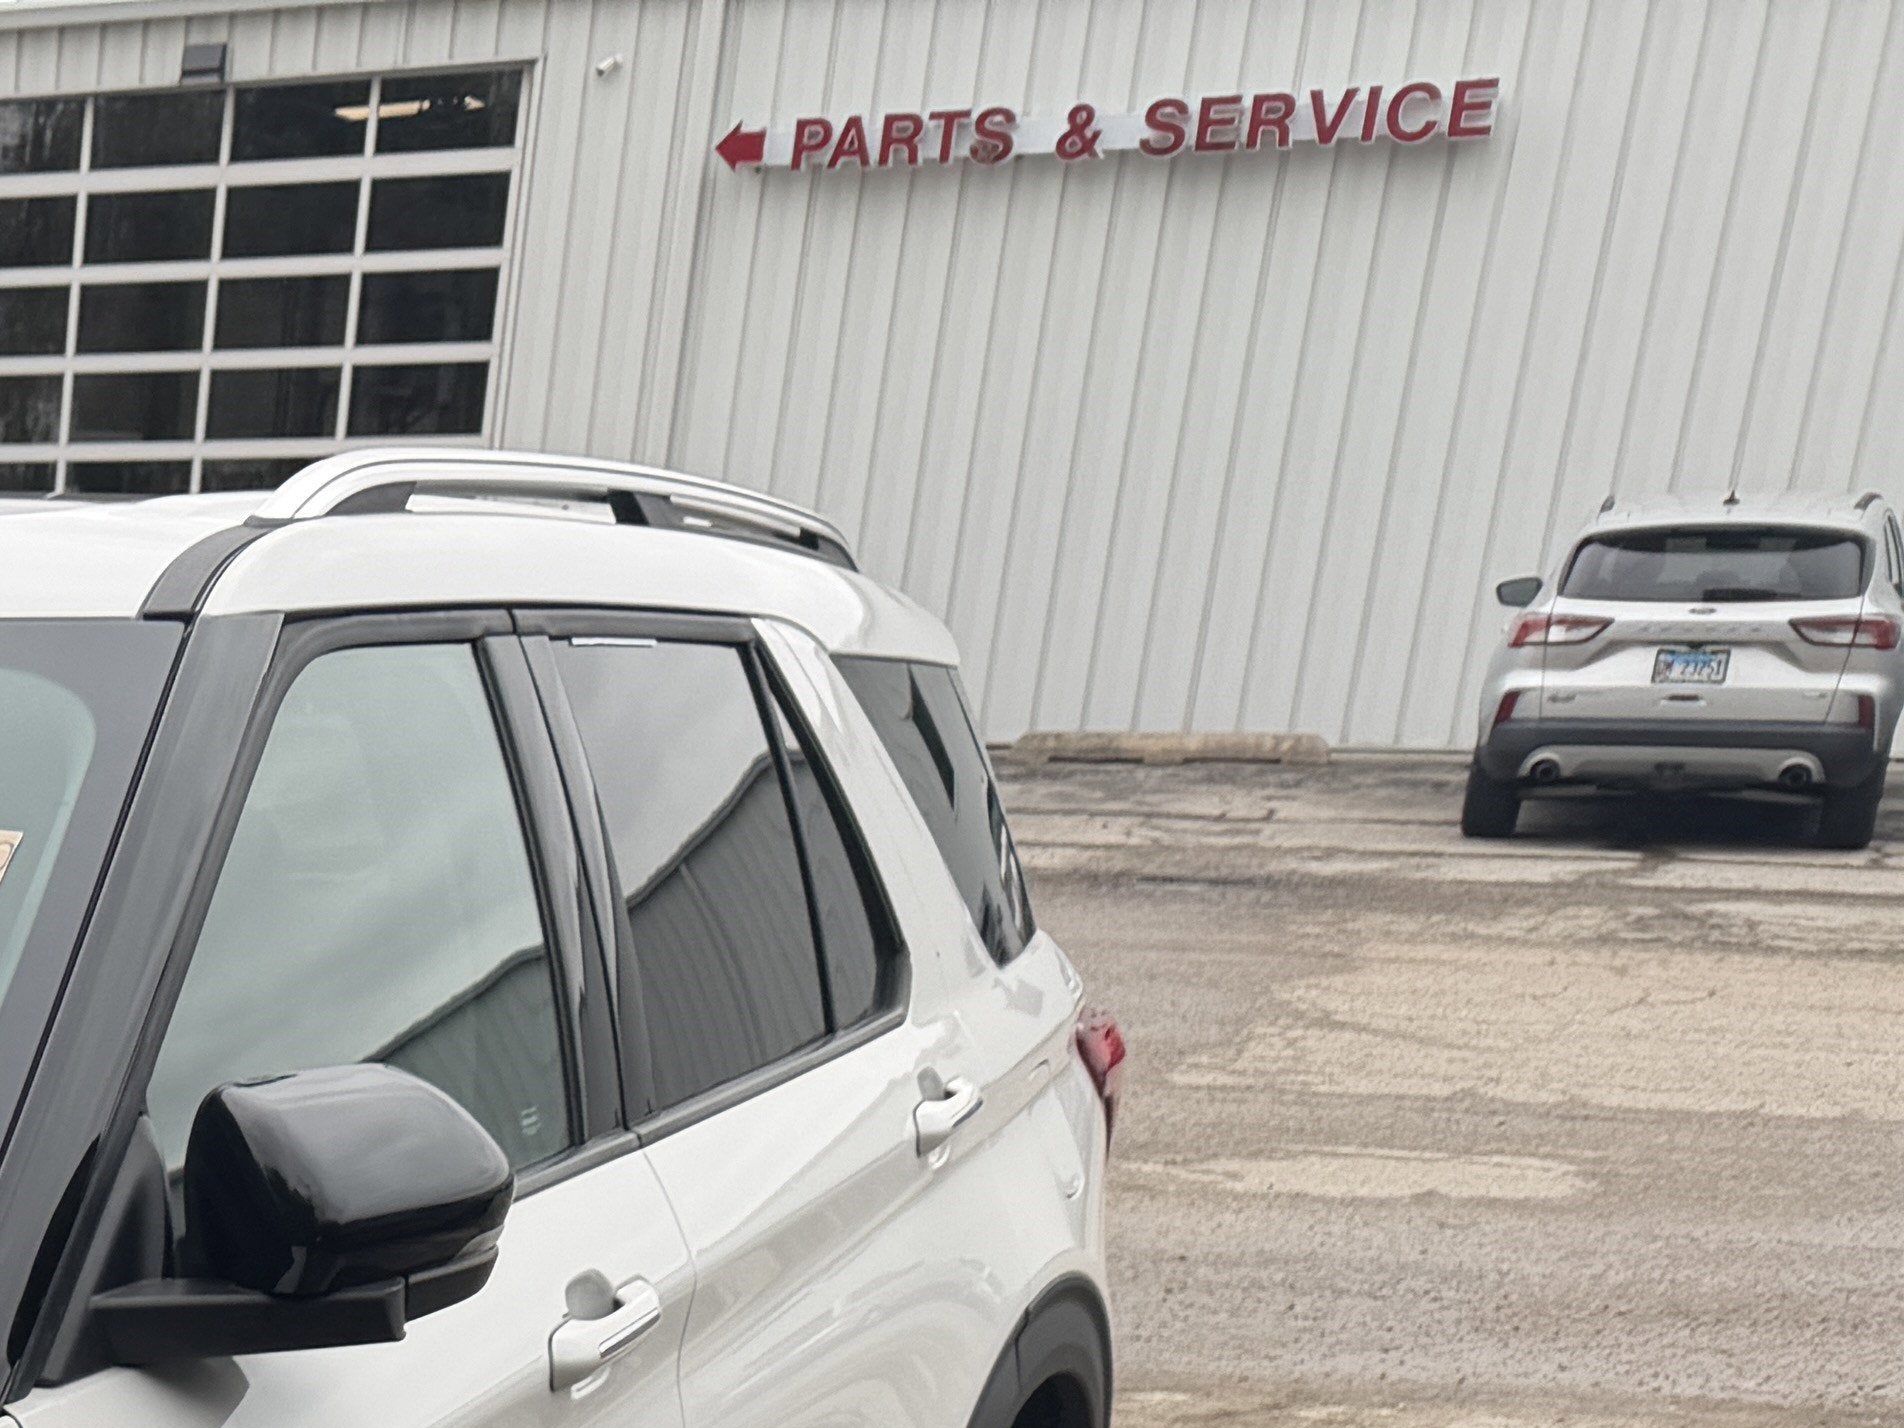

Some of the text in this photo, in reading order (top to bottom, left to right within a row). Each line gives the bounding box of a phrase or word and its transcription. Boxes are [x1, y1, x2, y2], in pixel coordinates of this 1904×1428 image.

[791, 78, 1501, 171] PARTS & SERVICE
